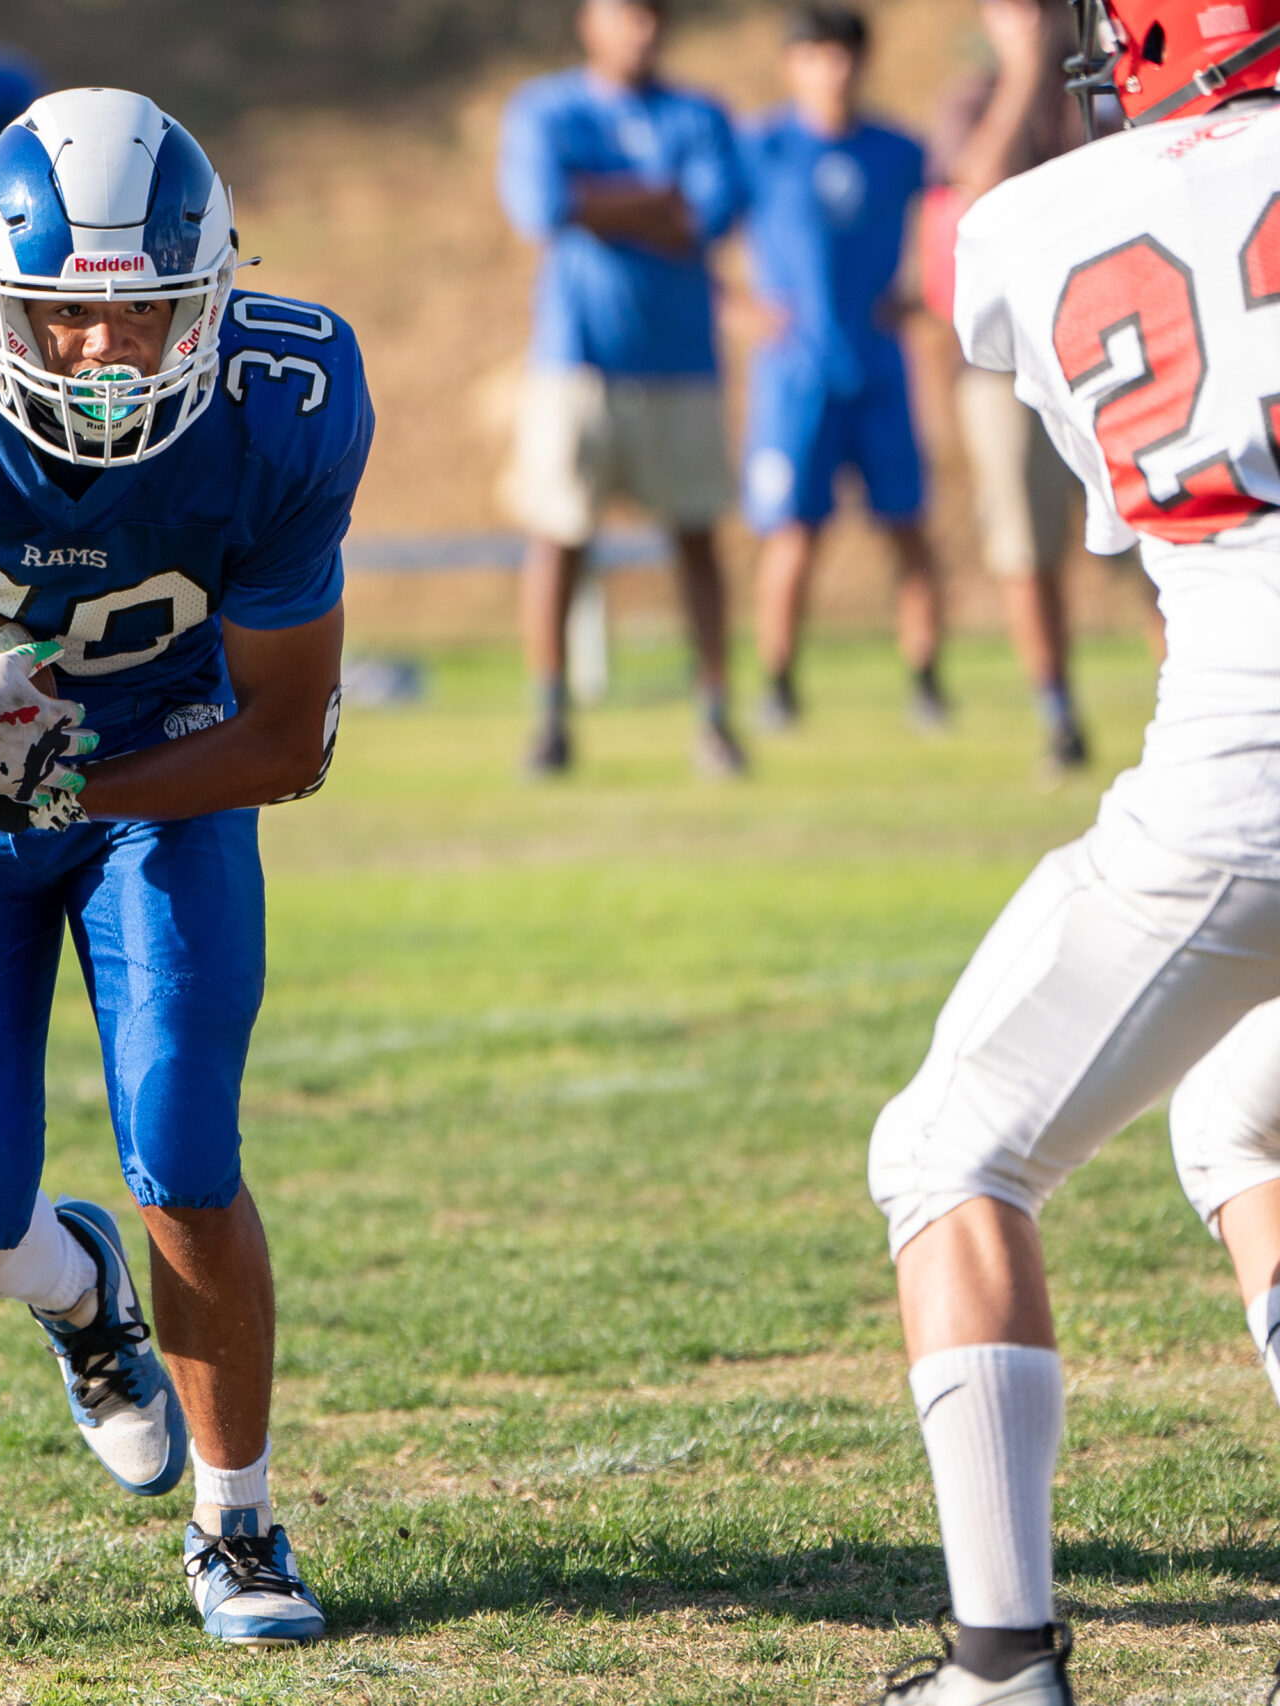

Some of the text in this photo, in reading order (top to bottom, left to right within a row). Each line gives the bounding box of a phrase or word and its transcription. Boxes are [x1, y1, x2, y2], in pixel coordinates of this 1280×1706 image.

[74, 256, 145, 272] Riddell
[222, 293, 338, 418] 30
[1053, 190, 1280, 545] 2
[21, 543, 108, 569] RAMS
